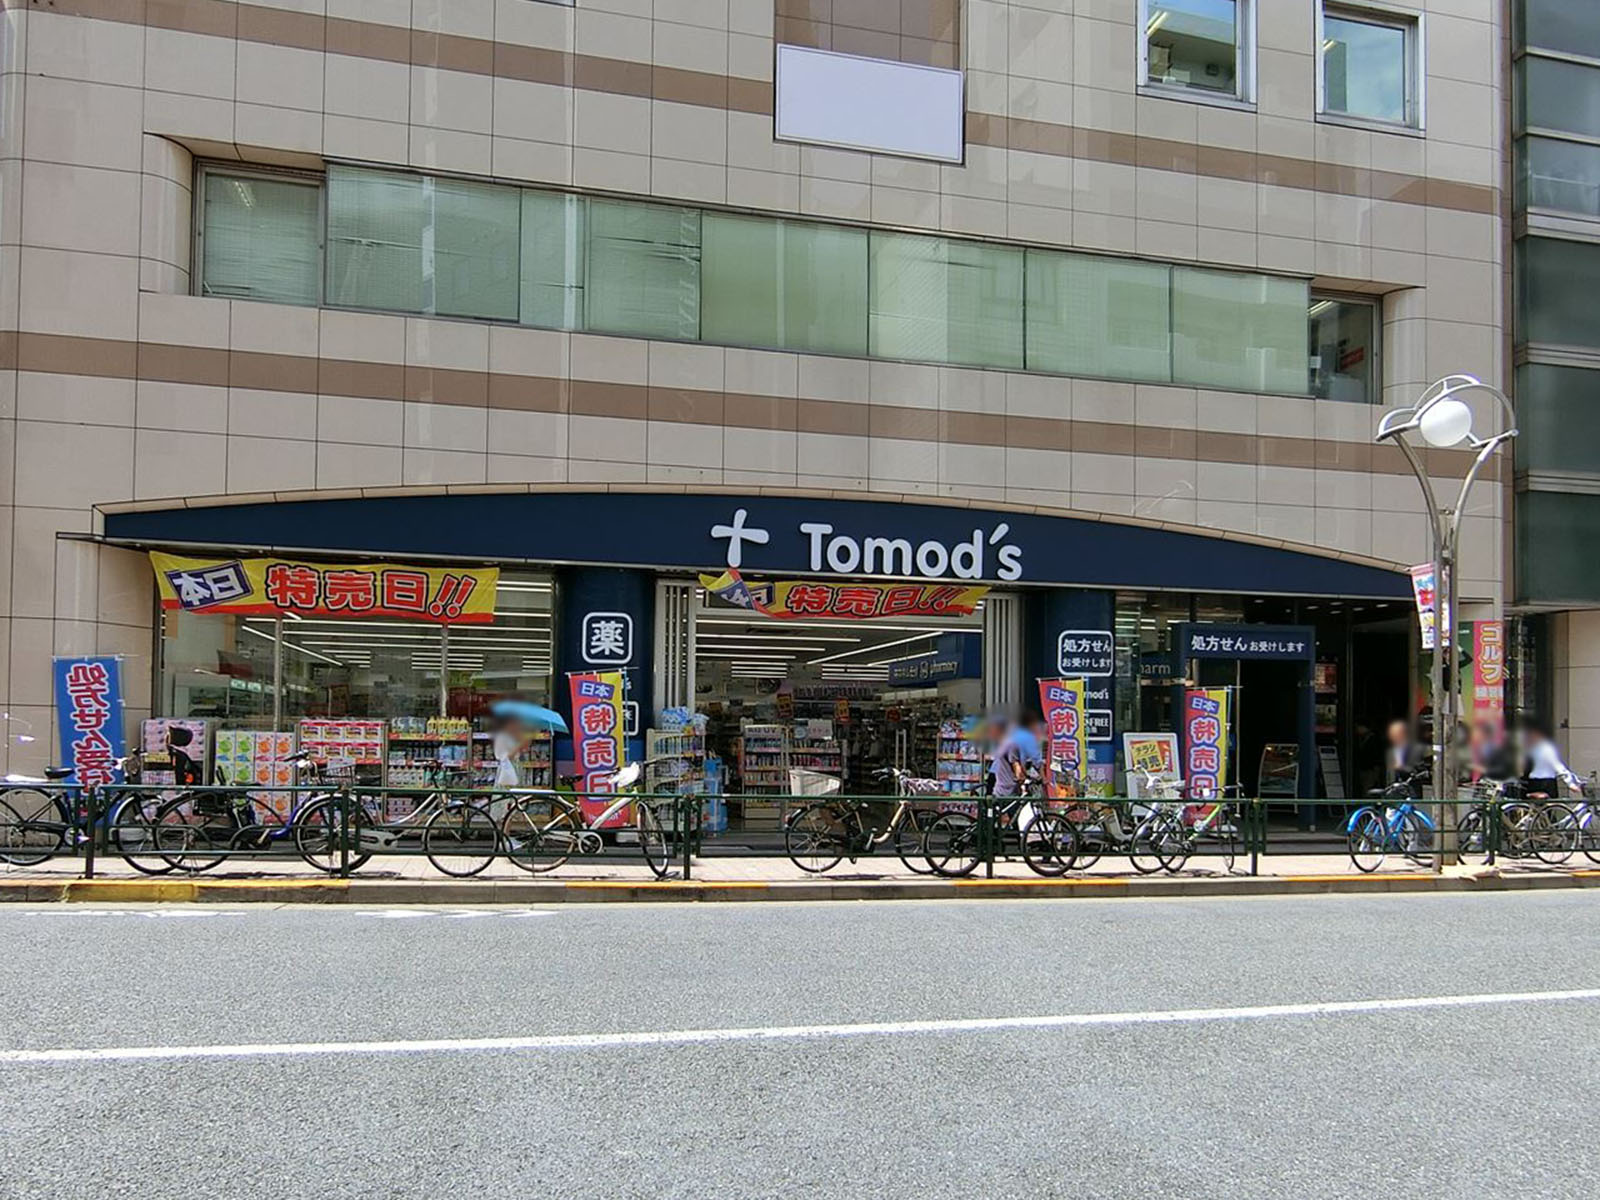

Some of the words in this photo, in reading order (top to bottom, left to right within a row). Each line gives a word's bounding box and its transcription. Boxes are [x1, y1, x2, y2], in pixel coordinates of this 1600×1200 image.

[800, 523, 1022, 581] Tomod's
[173, 567, 245, 605] 本日
[590, 620, 624, 655] 薬
[1063, 638, 1111, 653] 処方せん
[1191, 635, 1247, 651] 処方せん
[1250, 641, 1304, 653] お受けします
[1062, 657, 1111, 668] お受けします
[1084, 688, 1109, 700] mod's
